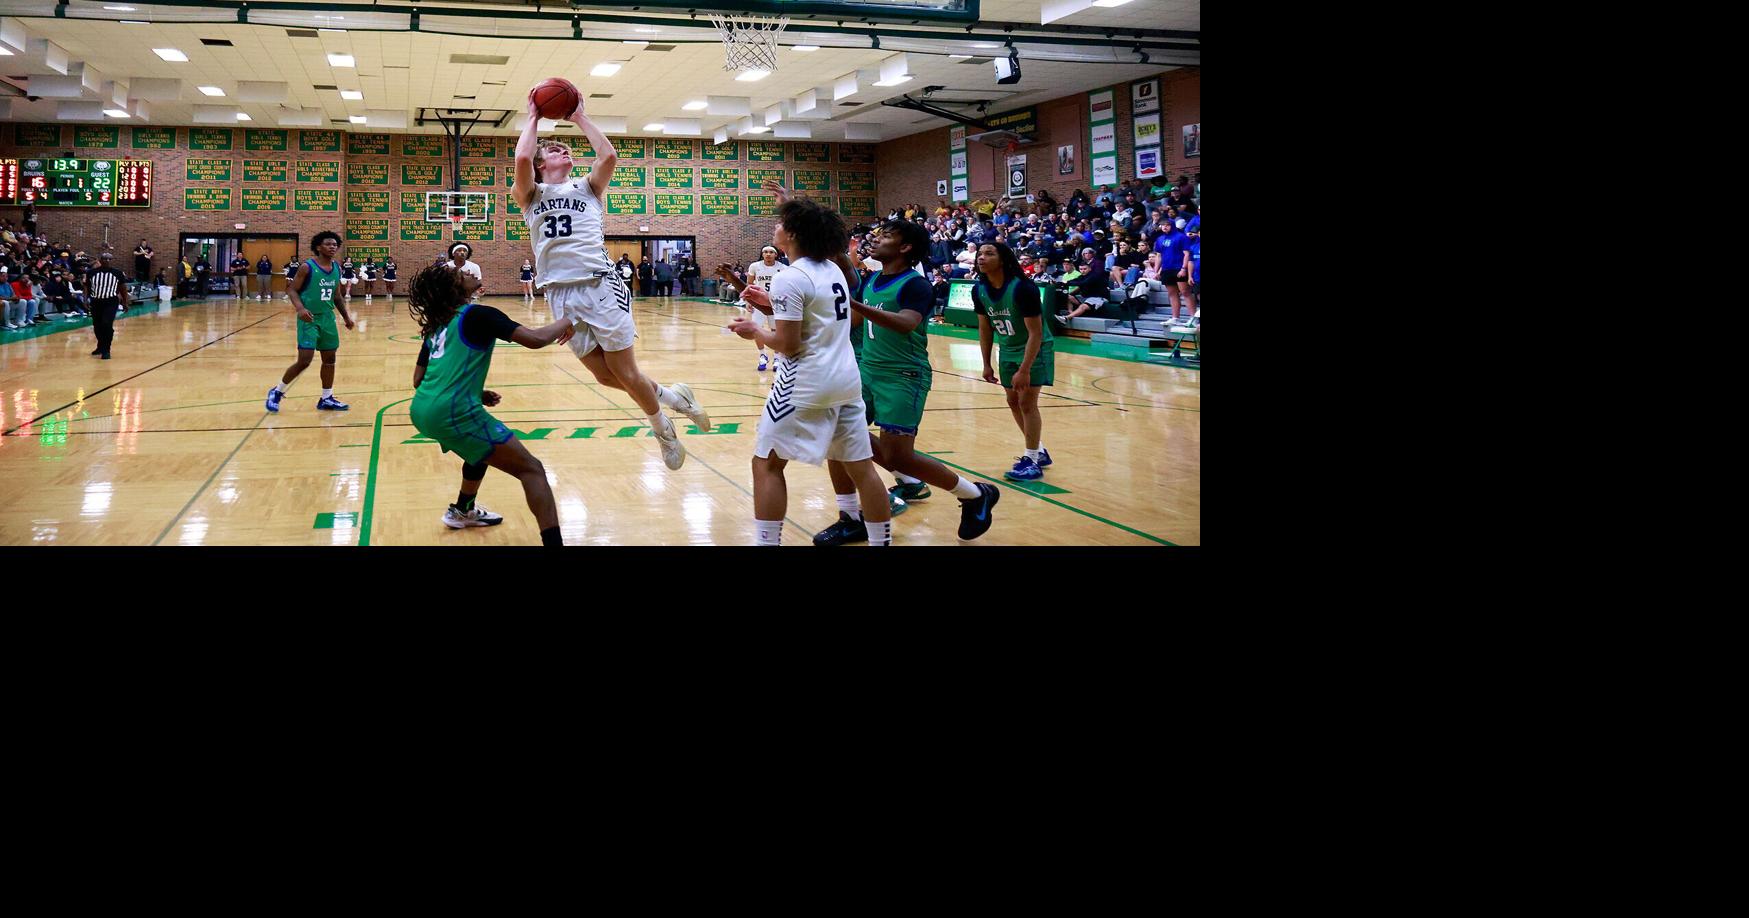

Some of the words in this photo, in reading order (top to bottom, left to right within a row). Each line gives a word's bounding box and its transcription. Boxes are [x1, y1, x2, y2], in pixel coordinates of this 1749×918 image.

[54, 160, 78, 170] 13.9
[32, 177, 44, 188] 16
[94, 178, 110, 188] 22
[26, 192, 34, 200] 5
[85, 192, 92, 201] 5
[102, 193, 110, 201] 2
[534, 198, 586, 215] ARTANS
[544, 215, 572, 238] 33
[765, 283, 770, 292] 5
[832, 282, 848, 321] 2
[987, 306, 1011, 316] South
